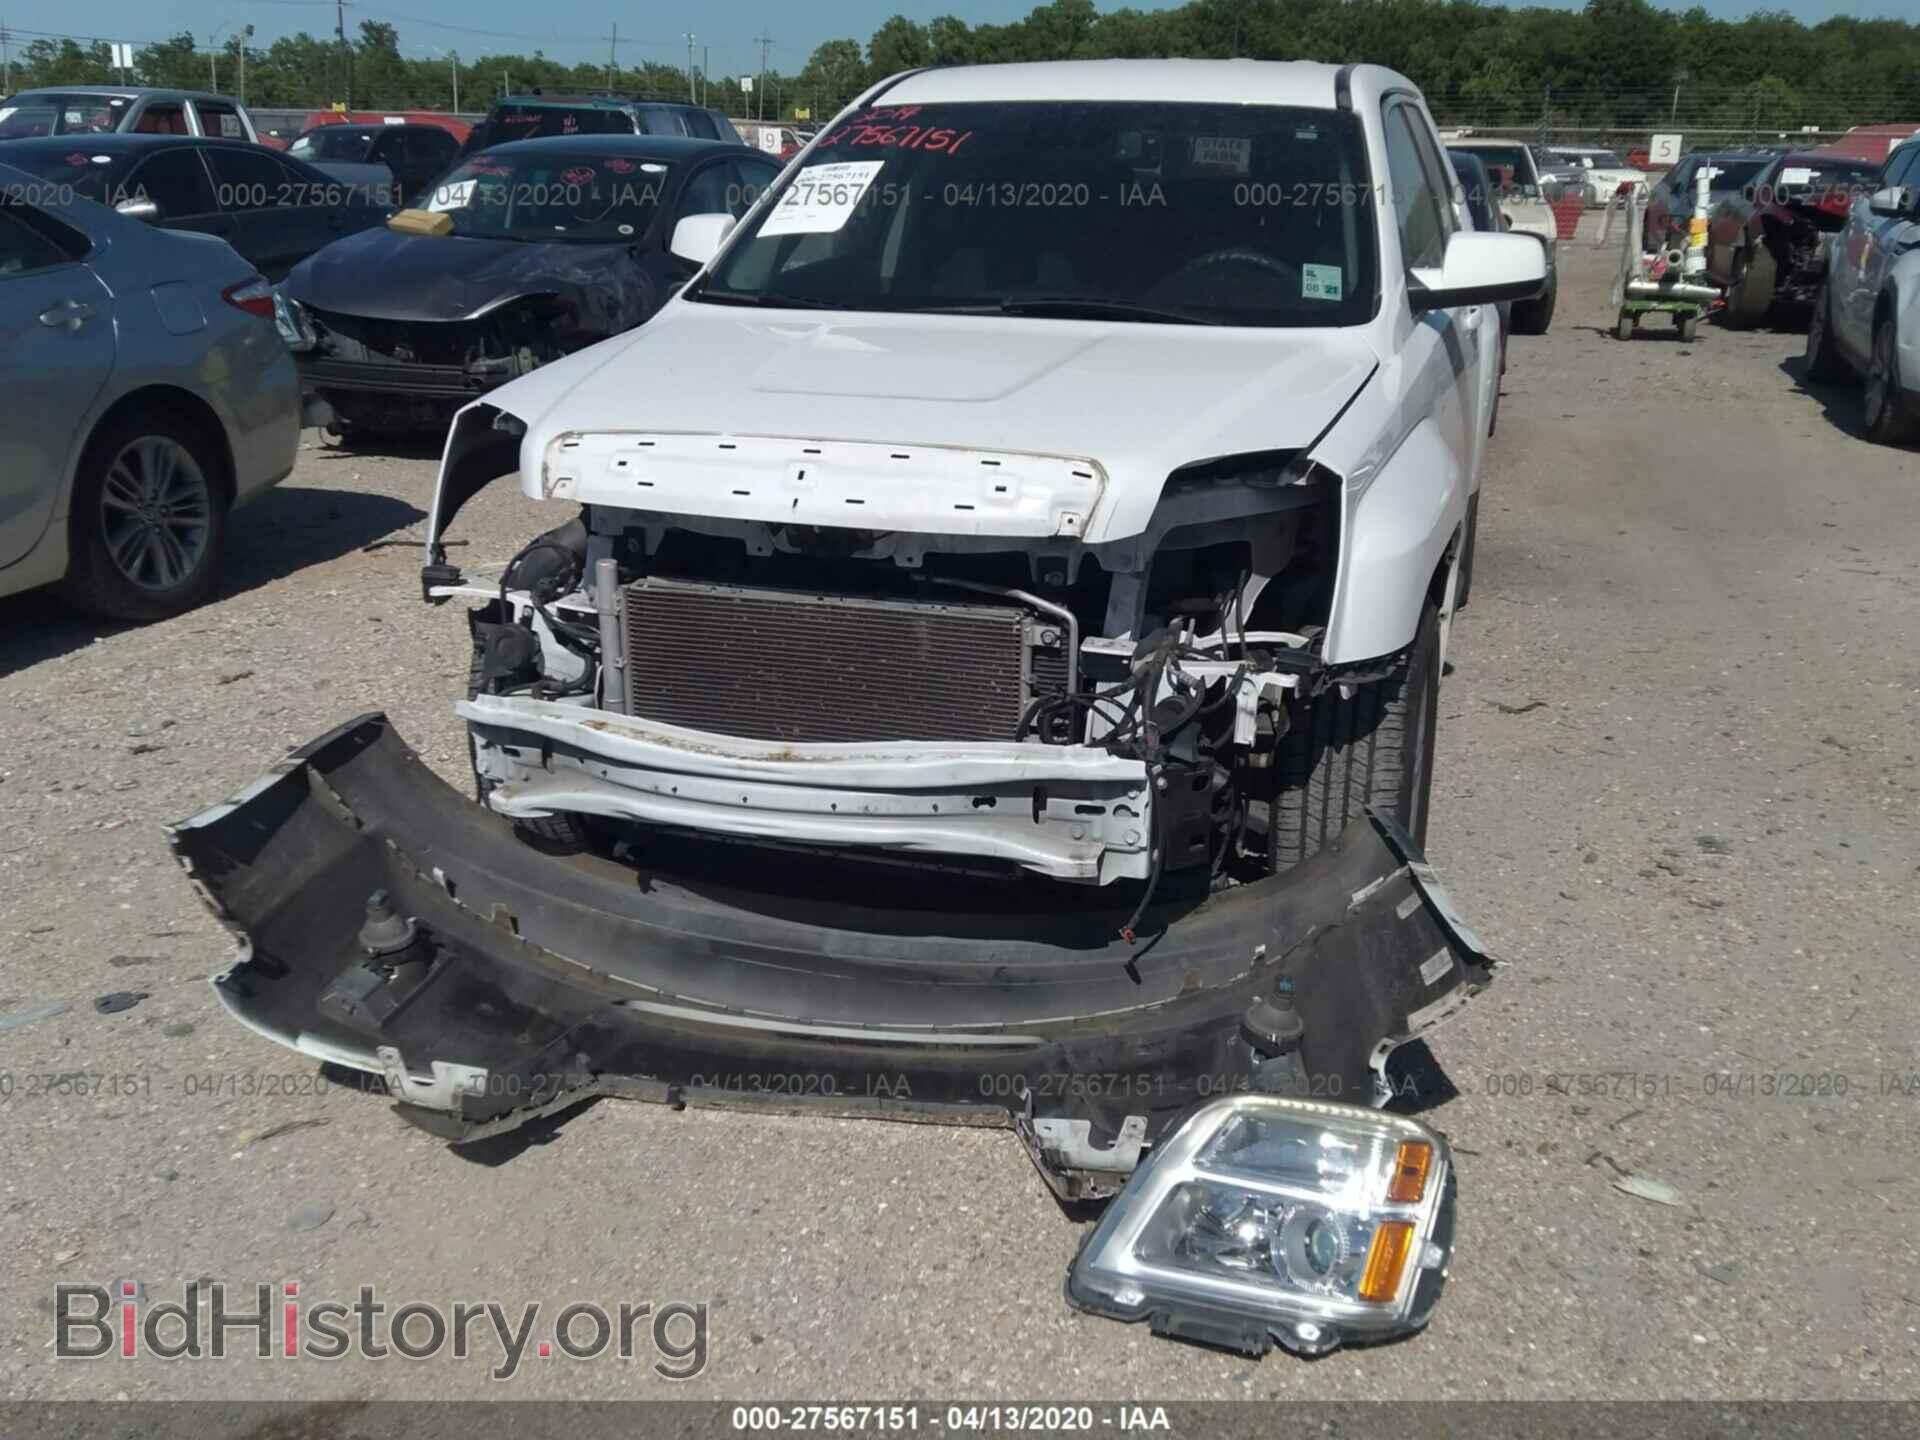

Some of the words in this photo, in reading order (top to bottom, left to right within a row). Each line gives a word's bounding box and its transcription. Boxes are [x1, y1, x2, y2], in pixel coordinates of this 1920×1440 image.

[766, 133, 775, 148] 9
[819, 125, 973, 155] 27567151
[1660, 140, 1672, 157] 5
